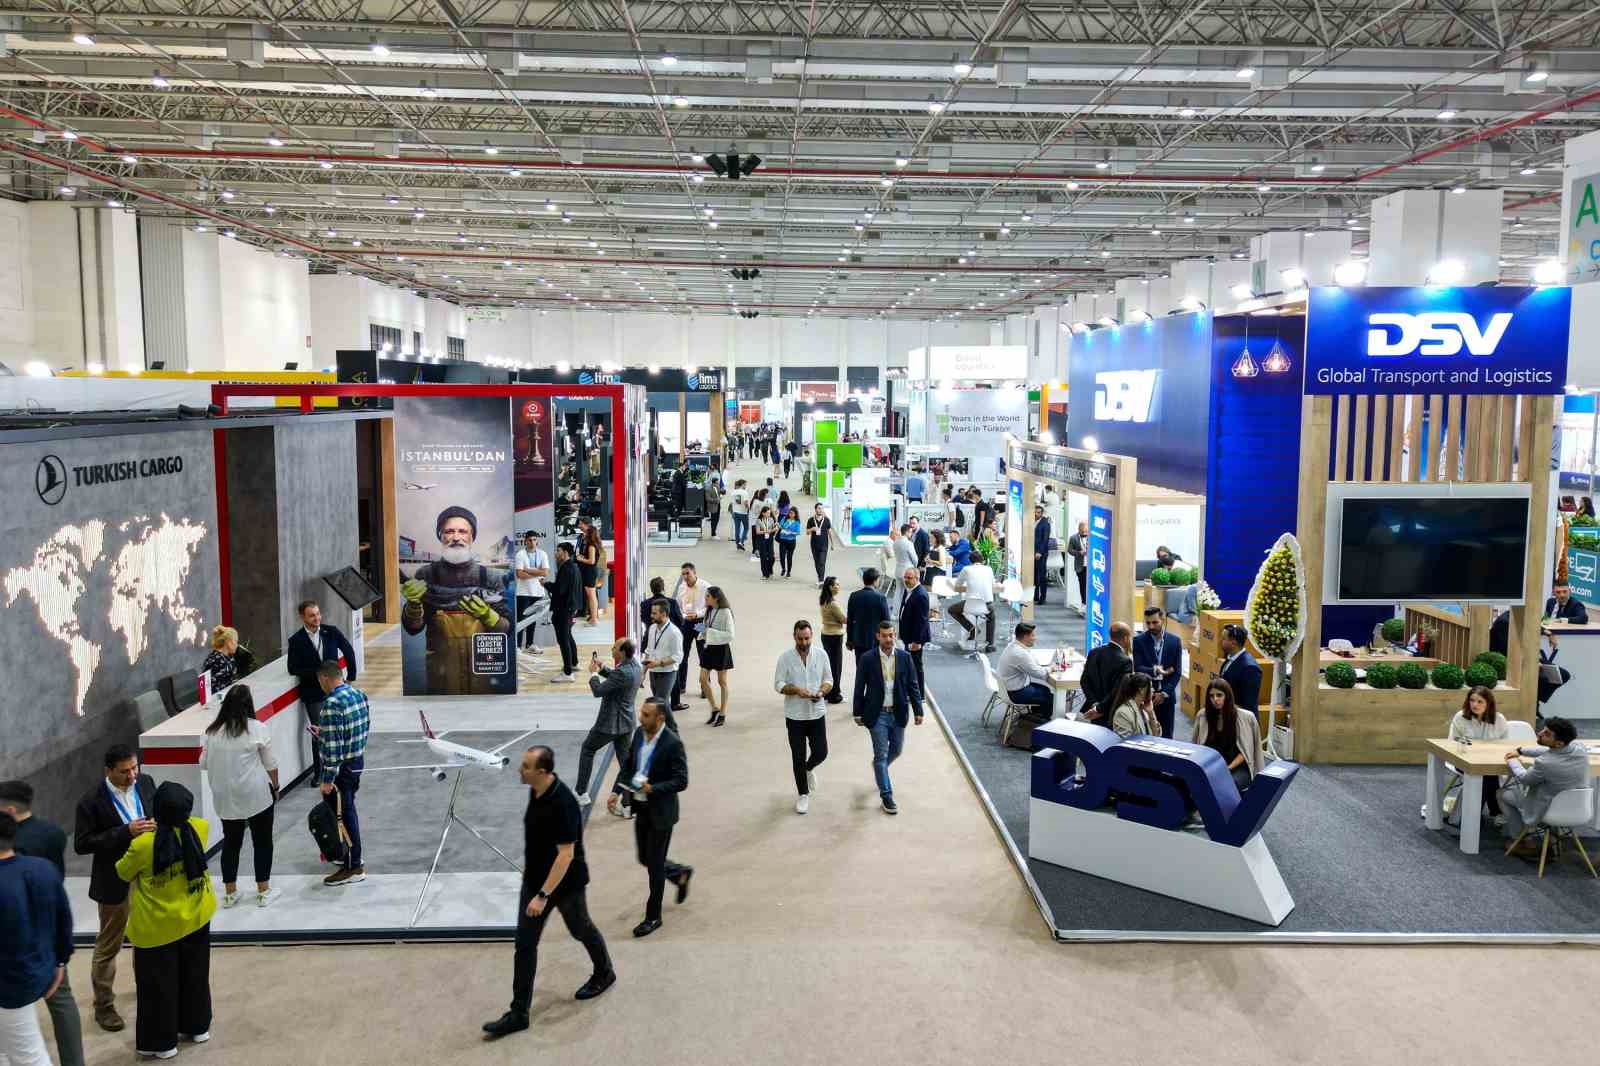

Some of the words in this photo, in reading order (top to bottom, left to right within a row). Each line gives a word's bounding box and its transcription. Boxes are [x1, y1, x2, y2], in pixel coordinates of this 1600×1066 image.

[1367, 312, 1513, 356] DSV
[1317, 367, 1366, 383] Global
[1371, 368, 1446, 387] Transport
[1449, 368, 1479, 383] and
[1485, 367, 1553, 387] Logistics
[72, 460, 137, 487] TURKISH
[139, 455, 184, 478] CARGO
[1031, 719, 1299, 848] DSV
